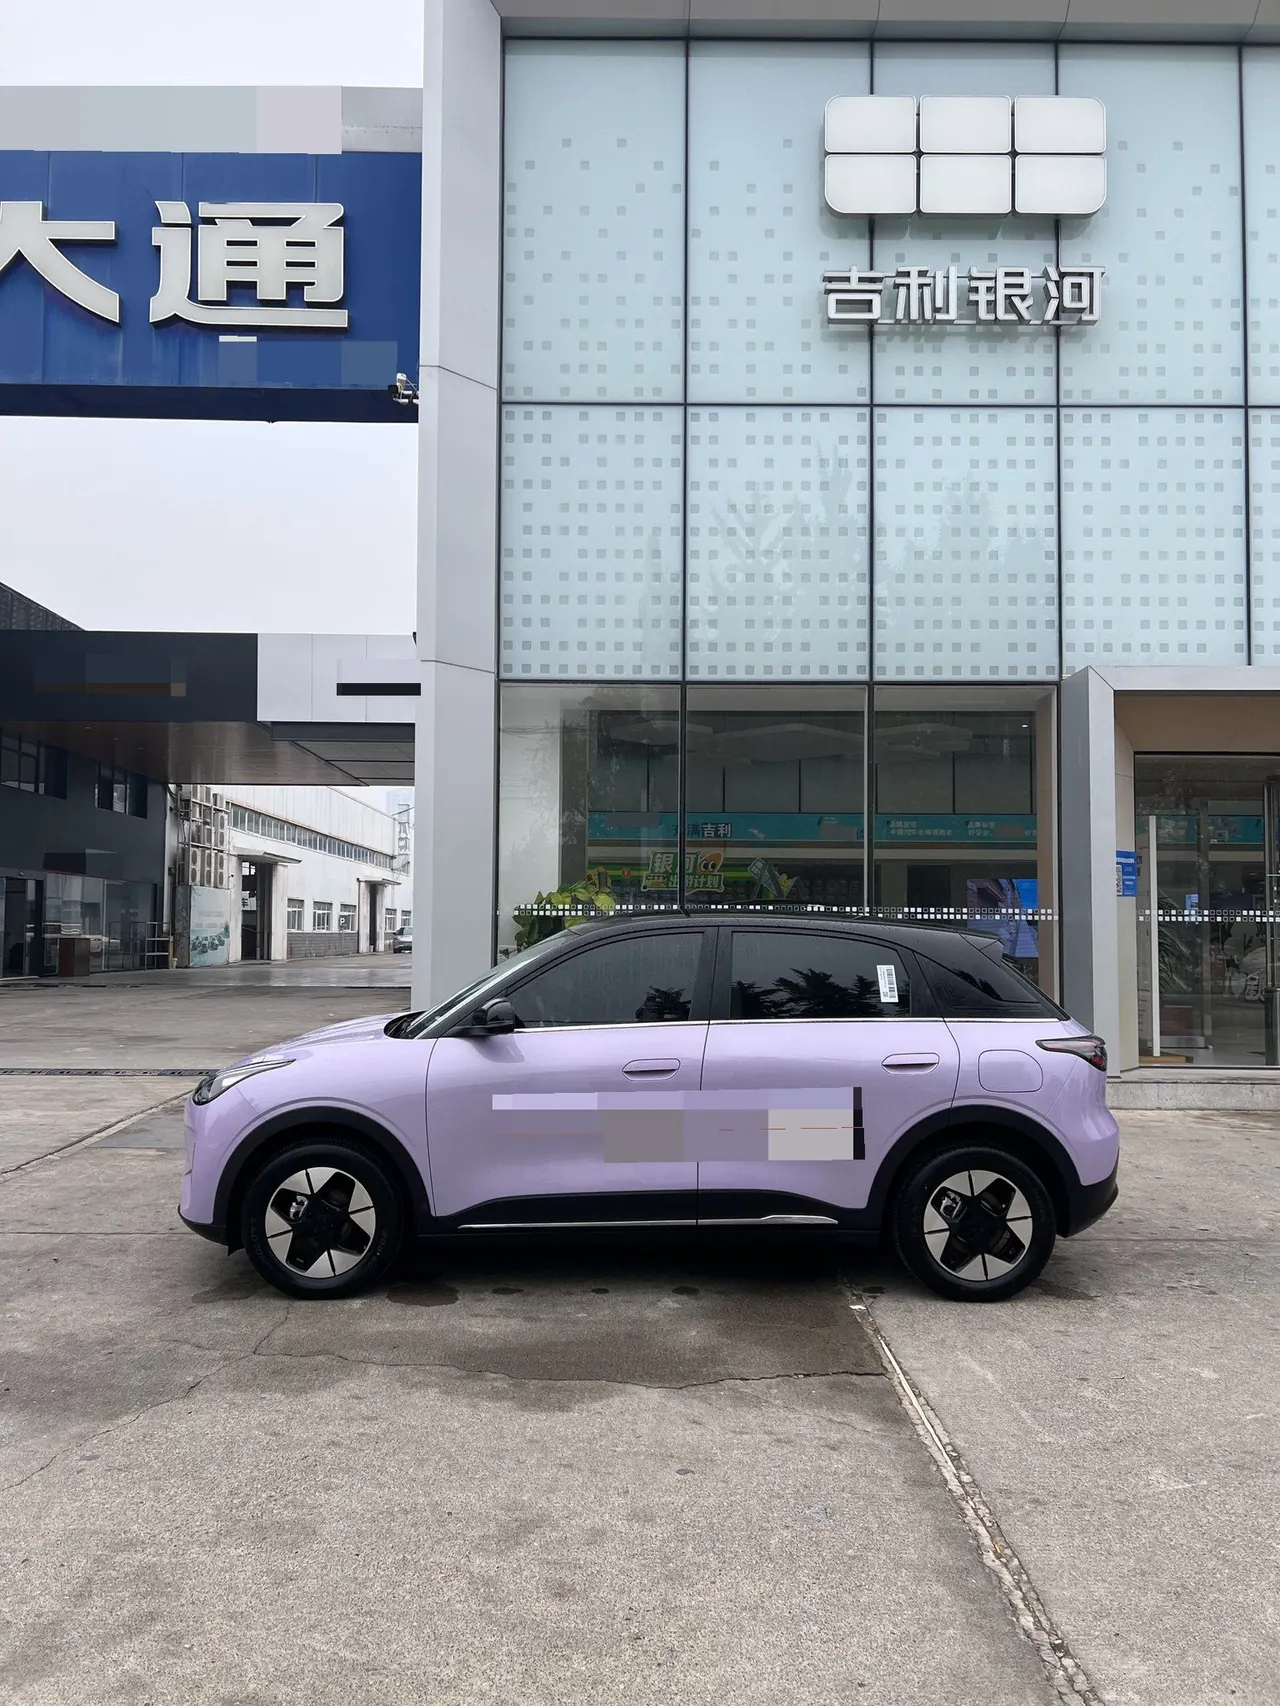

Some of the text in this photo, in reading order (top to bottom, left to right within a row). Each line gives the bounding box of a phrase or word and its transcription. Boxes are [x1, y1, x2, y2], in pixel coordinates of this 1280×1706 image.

[0, 201, 349, 328] 大通
[822, 265, 1106, 326] 吉利银河
[339, 917, 346, 926] P
